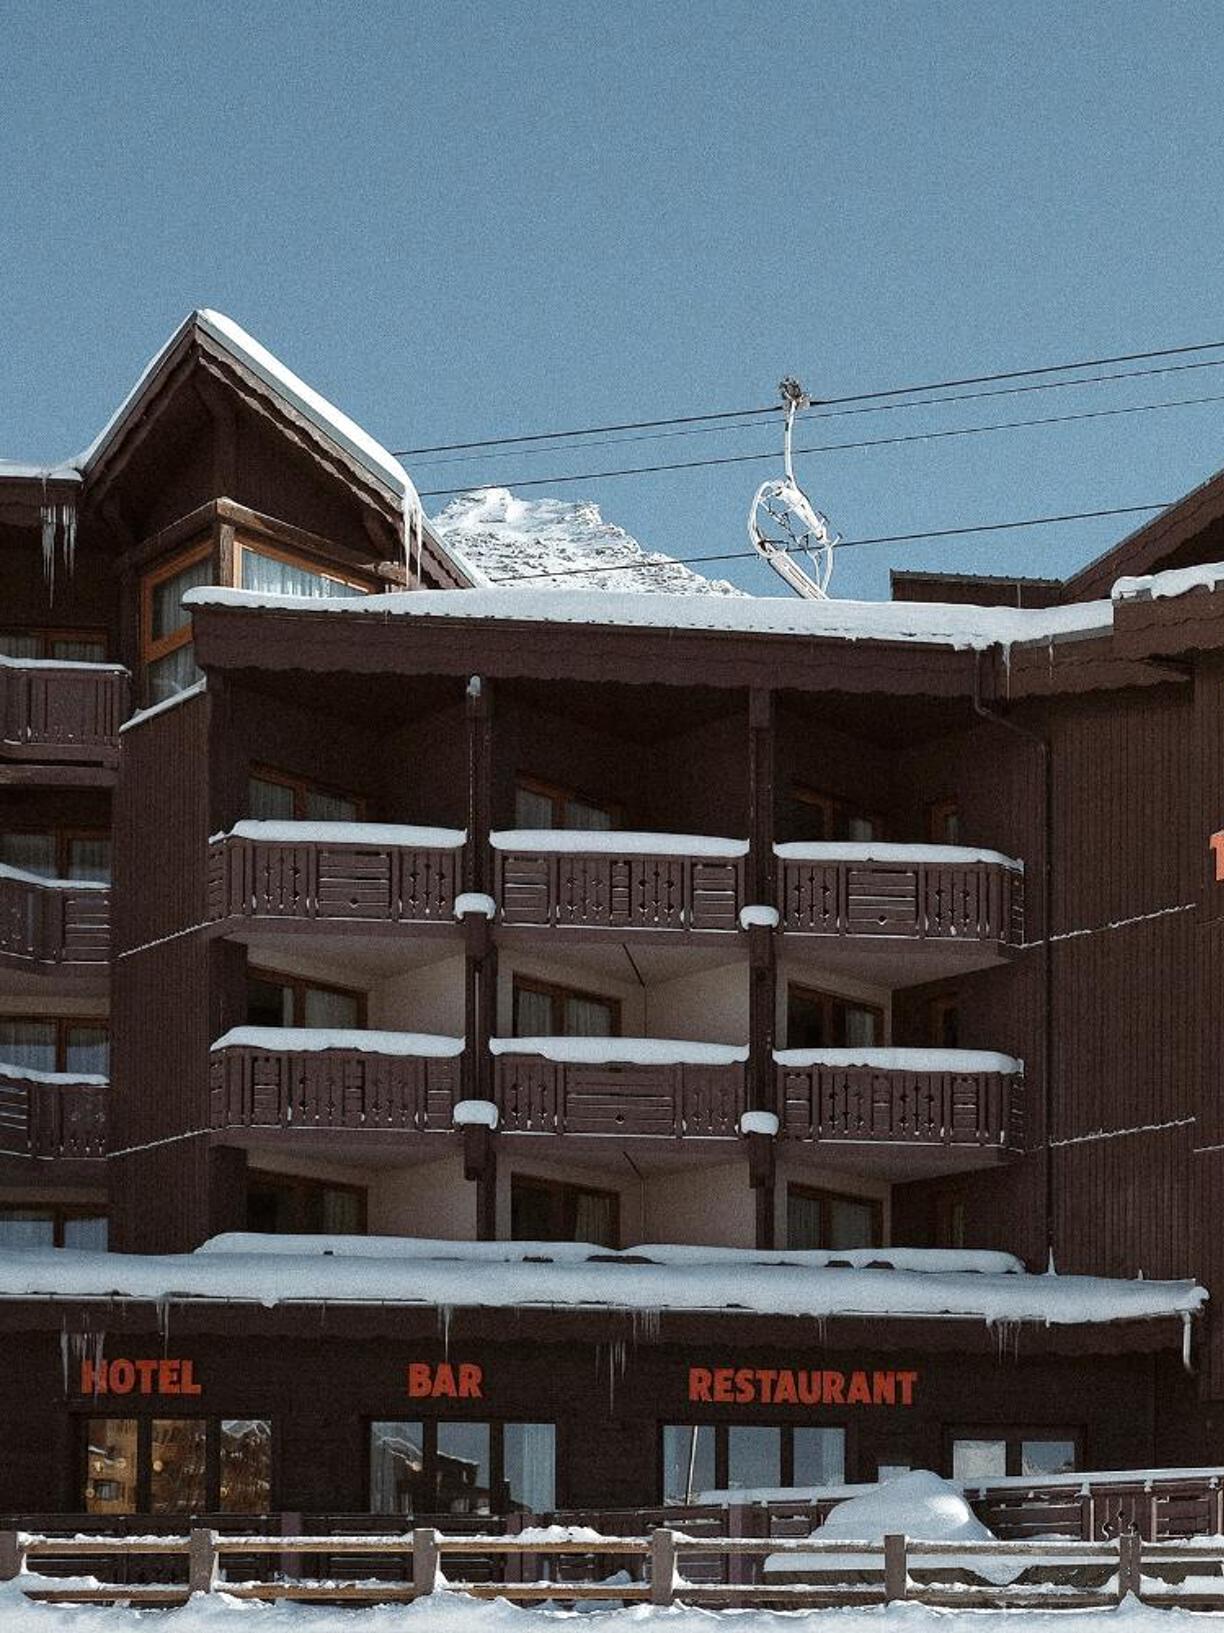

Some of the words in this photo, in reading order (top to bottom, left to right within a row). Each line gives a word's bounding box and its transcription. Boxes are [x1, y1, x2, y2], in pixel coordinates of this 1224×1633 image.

[81, 1359, 202, 1395] HOTEL
[407, 1363, 483, 1398] BAR
[688, 1367, 917, 1405] RESTAURANT
